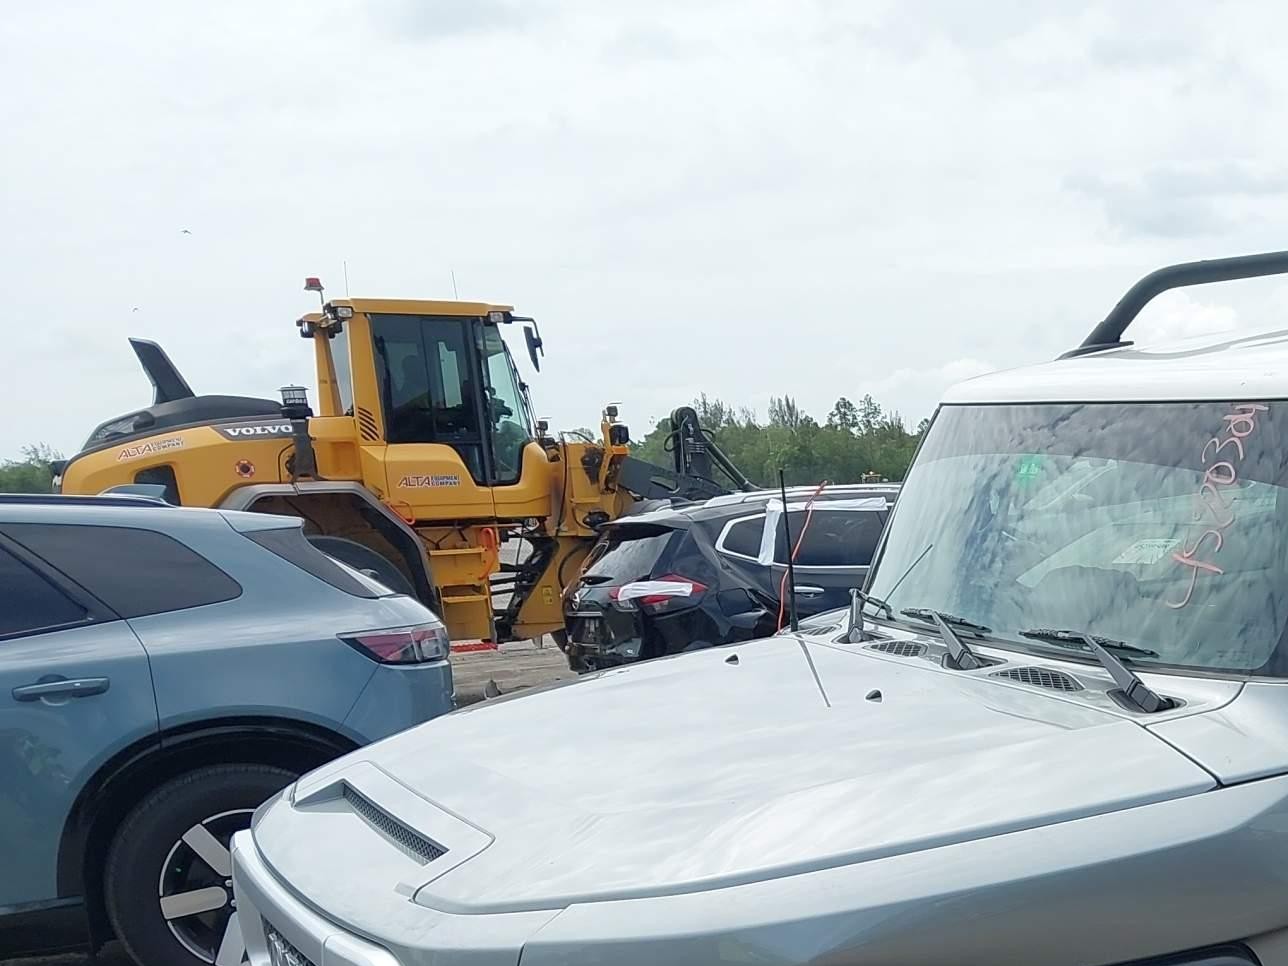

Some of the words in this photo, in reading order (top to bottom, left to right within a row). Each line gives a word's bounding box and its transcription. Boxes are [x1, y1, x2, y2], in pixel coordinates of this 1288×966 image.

[223, 424, 293, 436] VOLVO
[118, 442, 153, 460] ALTA
[398, 475, 431, 487] ALTA
